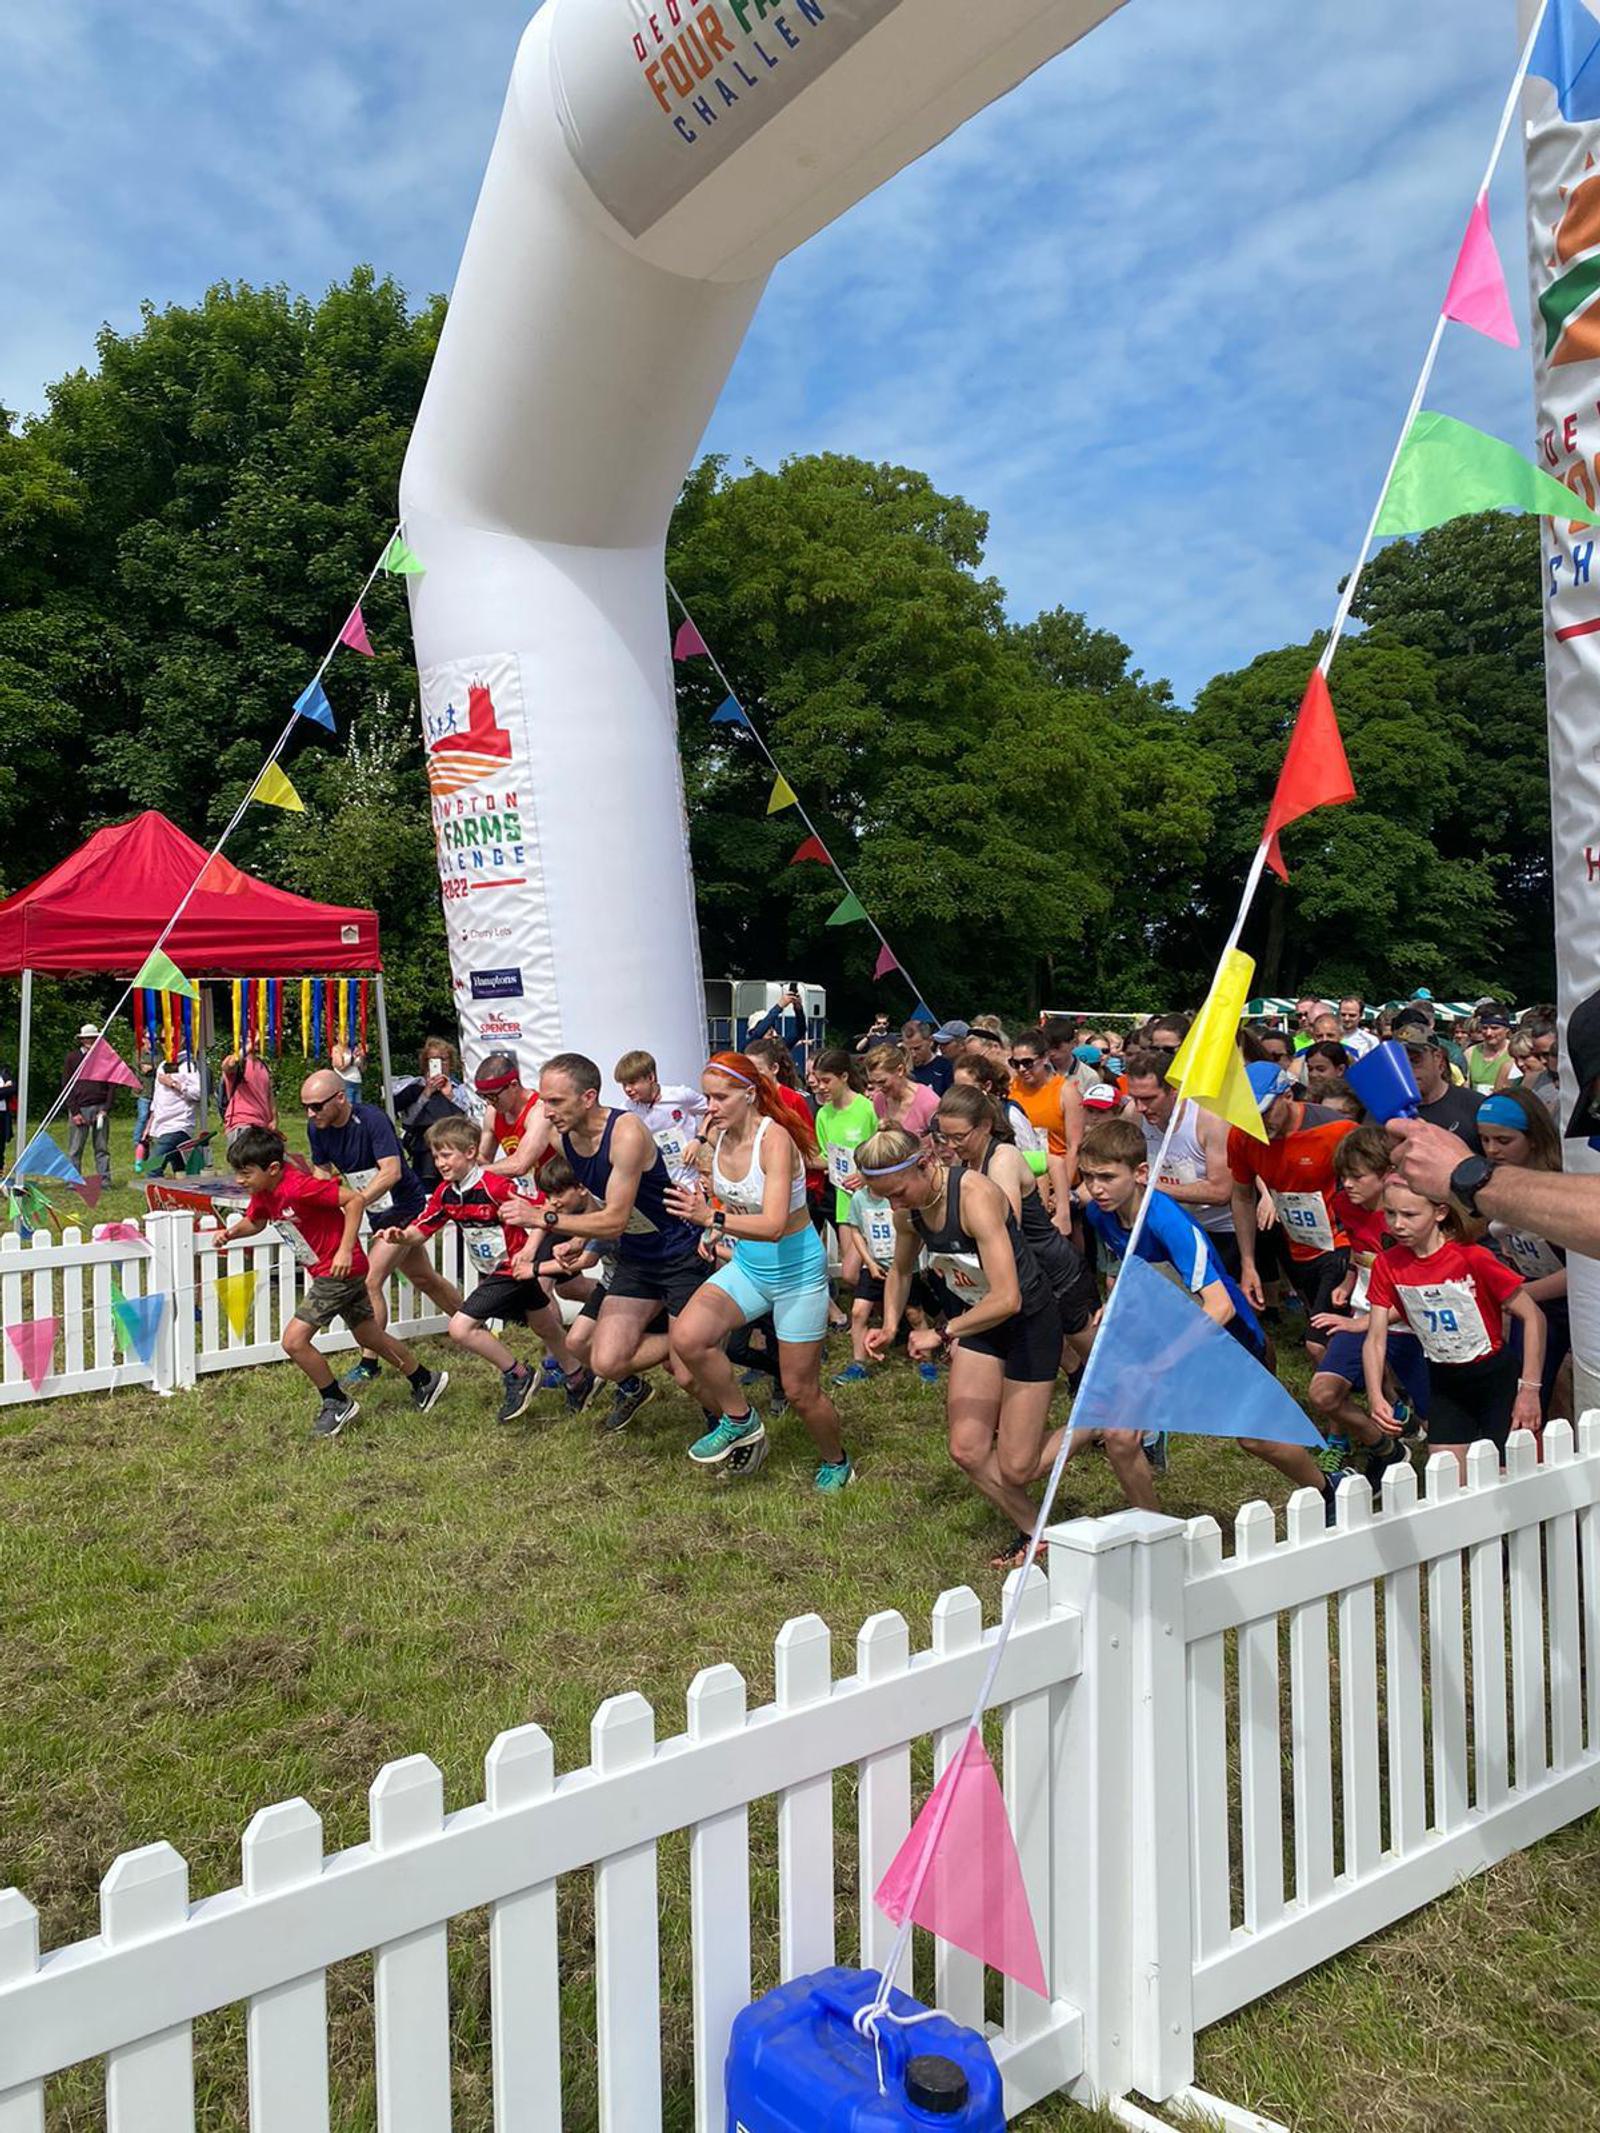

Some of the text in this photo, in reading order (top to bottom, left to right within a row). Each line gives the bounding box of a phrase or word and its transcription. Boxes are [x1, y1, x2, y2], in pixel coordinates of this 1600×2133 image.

[632, 0, 699, 62] DED
[644, 4, 735, 114] FOUR
[1544, 401, 1600, 467] DE
[444, 813, 521, 850] FARMS
[443, 878, 469, 899] 2022
[473, 976, 517, 988] Hamptons
[480, 1023, 521, 1034] SPENCER
[1283, 1208, 1317, 1227] 139
[872, 1224, 891, 1239] 59
[1423, 1309, 1458, 1333] 79
